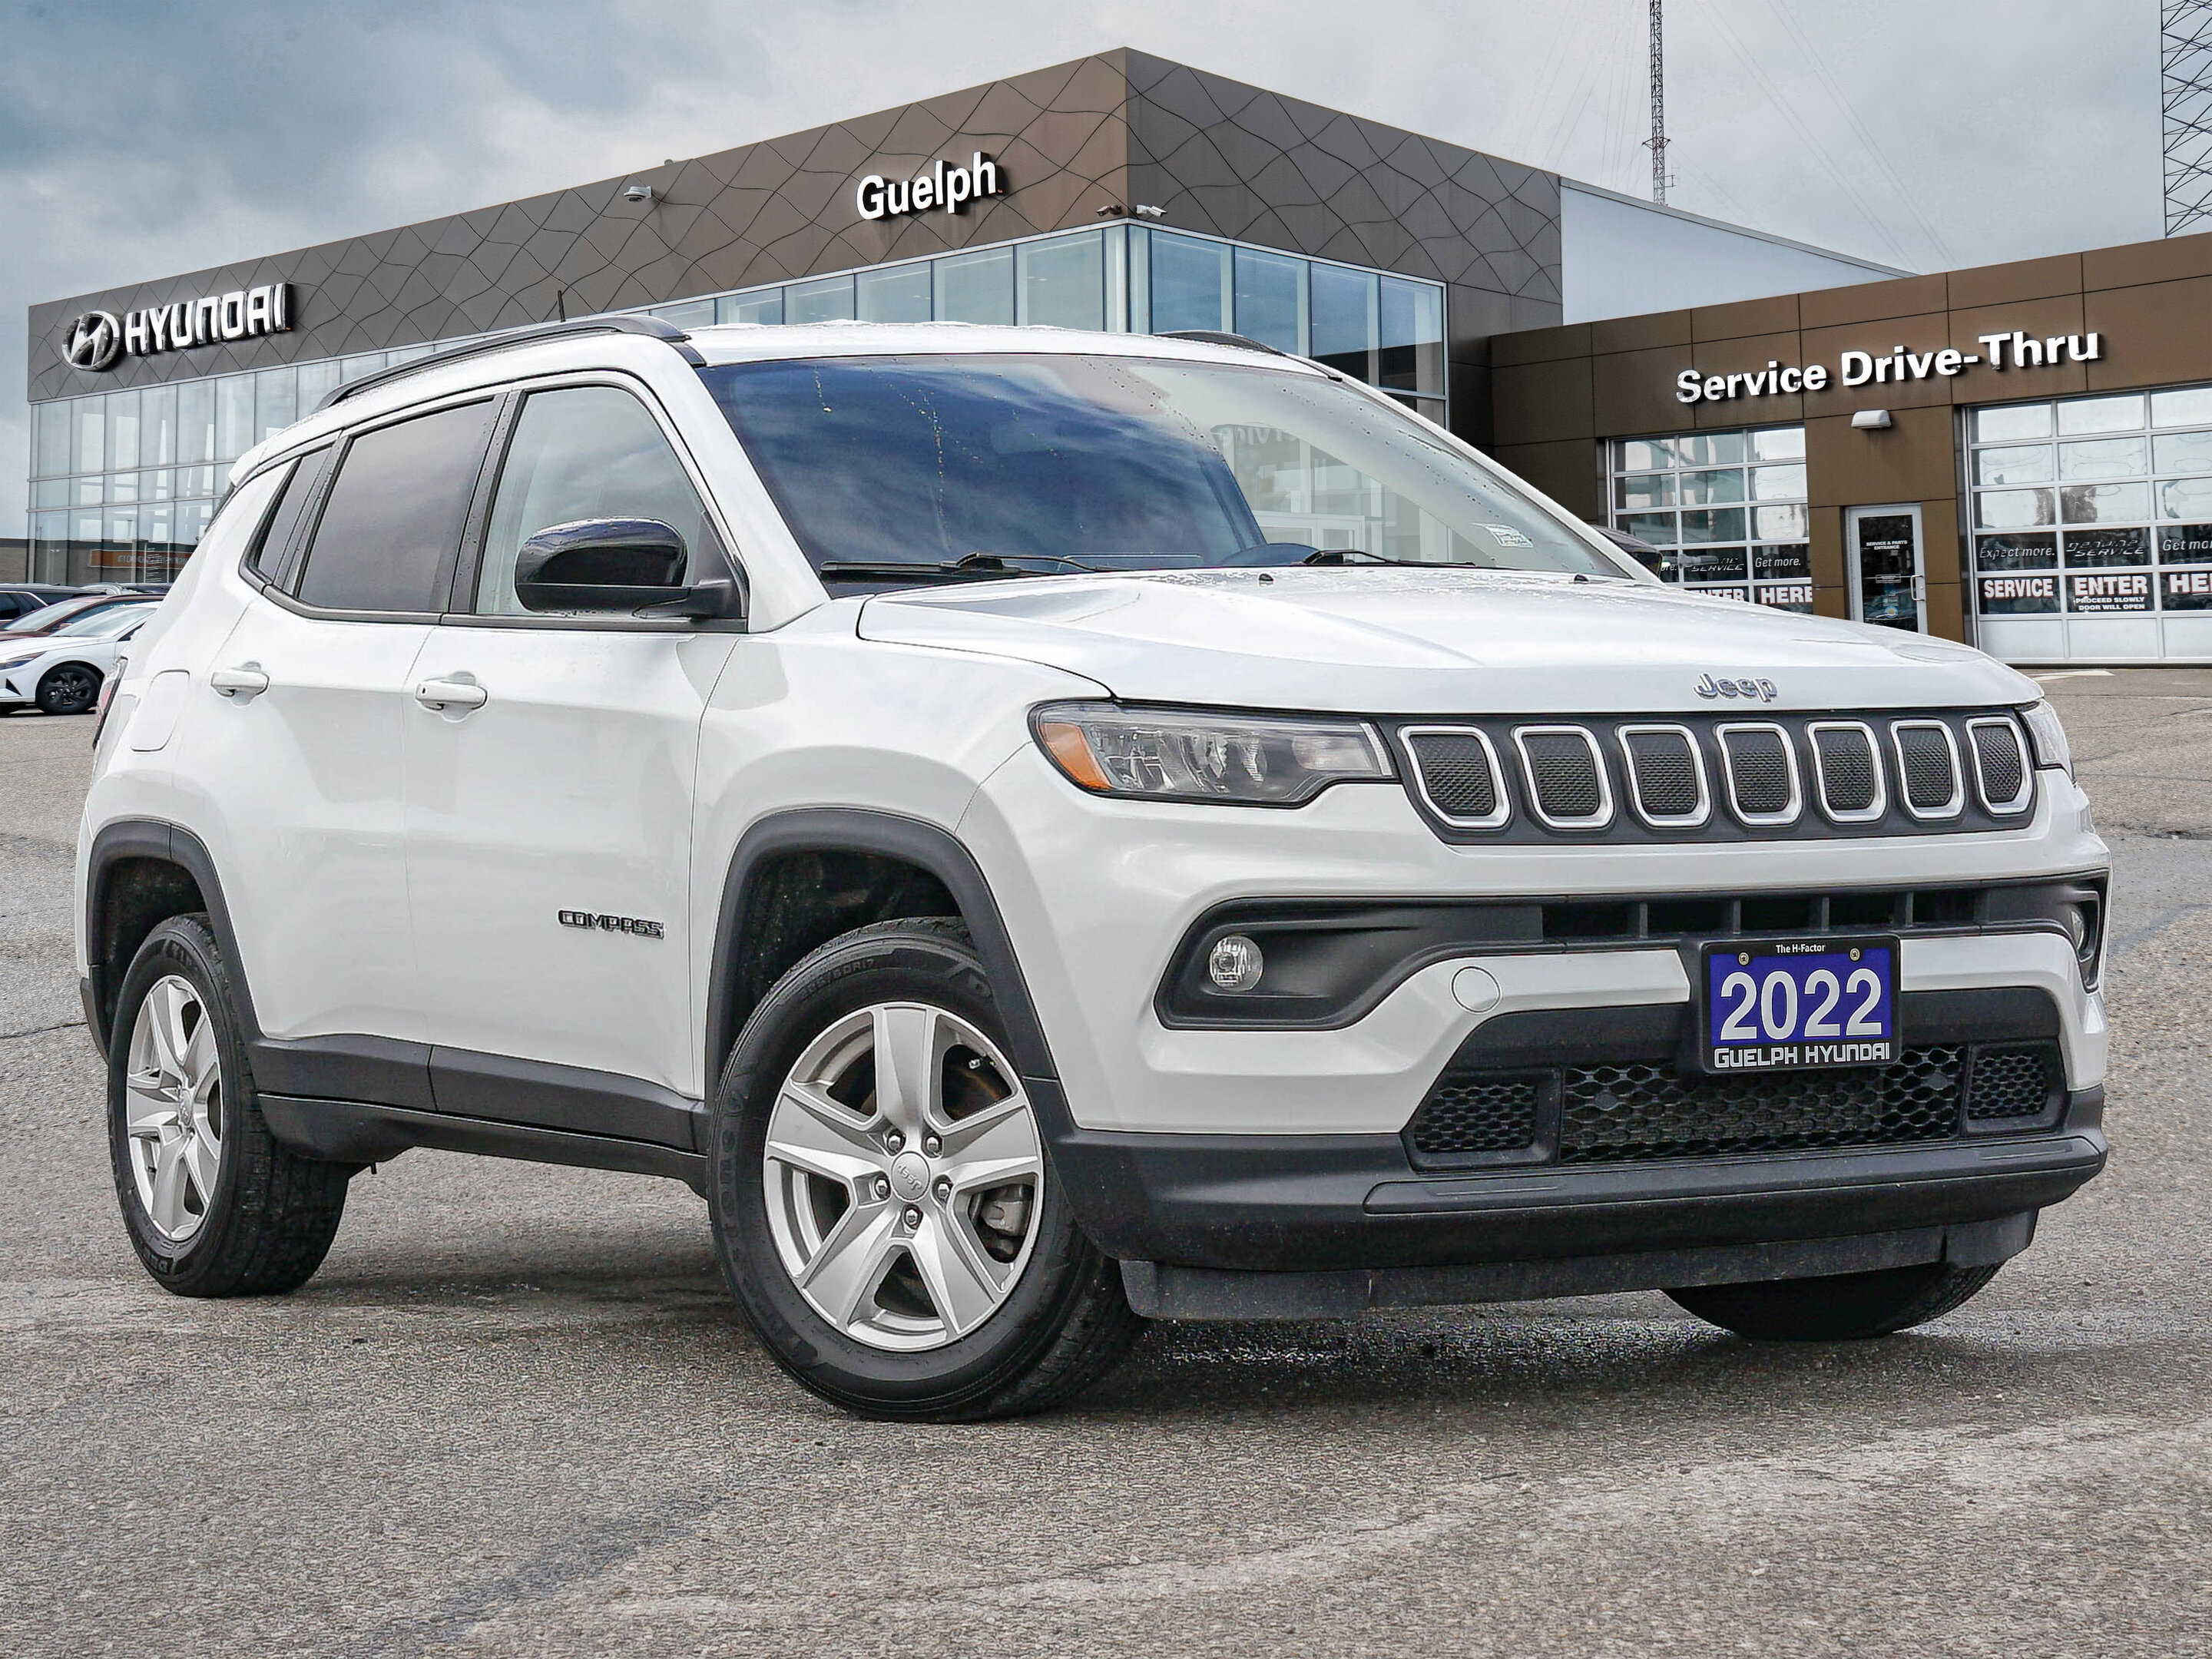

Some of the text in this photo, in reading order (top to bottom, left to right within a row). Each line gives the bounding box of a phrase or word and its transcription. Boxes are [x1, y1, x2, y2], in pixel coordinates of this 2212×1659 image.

[856, 151, 997, 220] Guelph
[124, 283, 287, 356] HYUNDAI
[1675, 330, 2102, 403] Service Drive-Thru
[1979, 547, 2055, 560] Expect more.
[2065, 539, 2138, 552] genuine
[2074, 546, 2146, 557] SERVICE
[2162, 539, 2186, 551] Get
[1755, 557, 1801, 568] Get more.
[1984, 578, 2054, 598] SERVICE
[2075, 575, 2148, 595] ENTER
[2170, 573, 2212, 594] HE
[1761, 587, 1813, 604] HERE
[1691, 673, 1778, 704] Jeep
[558, 909, 664, 939] COMPASS
[1775, 943, 1826, 954] The H-Factor
[1720, 968, 1883, 1041] 2022
[1714, 1041, 1890, 1068] GUELPH HYUNDAI
